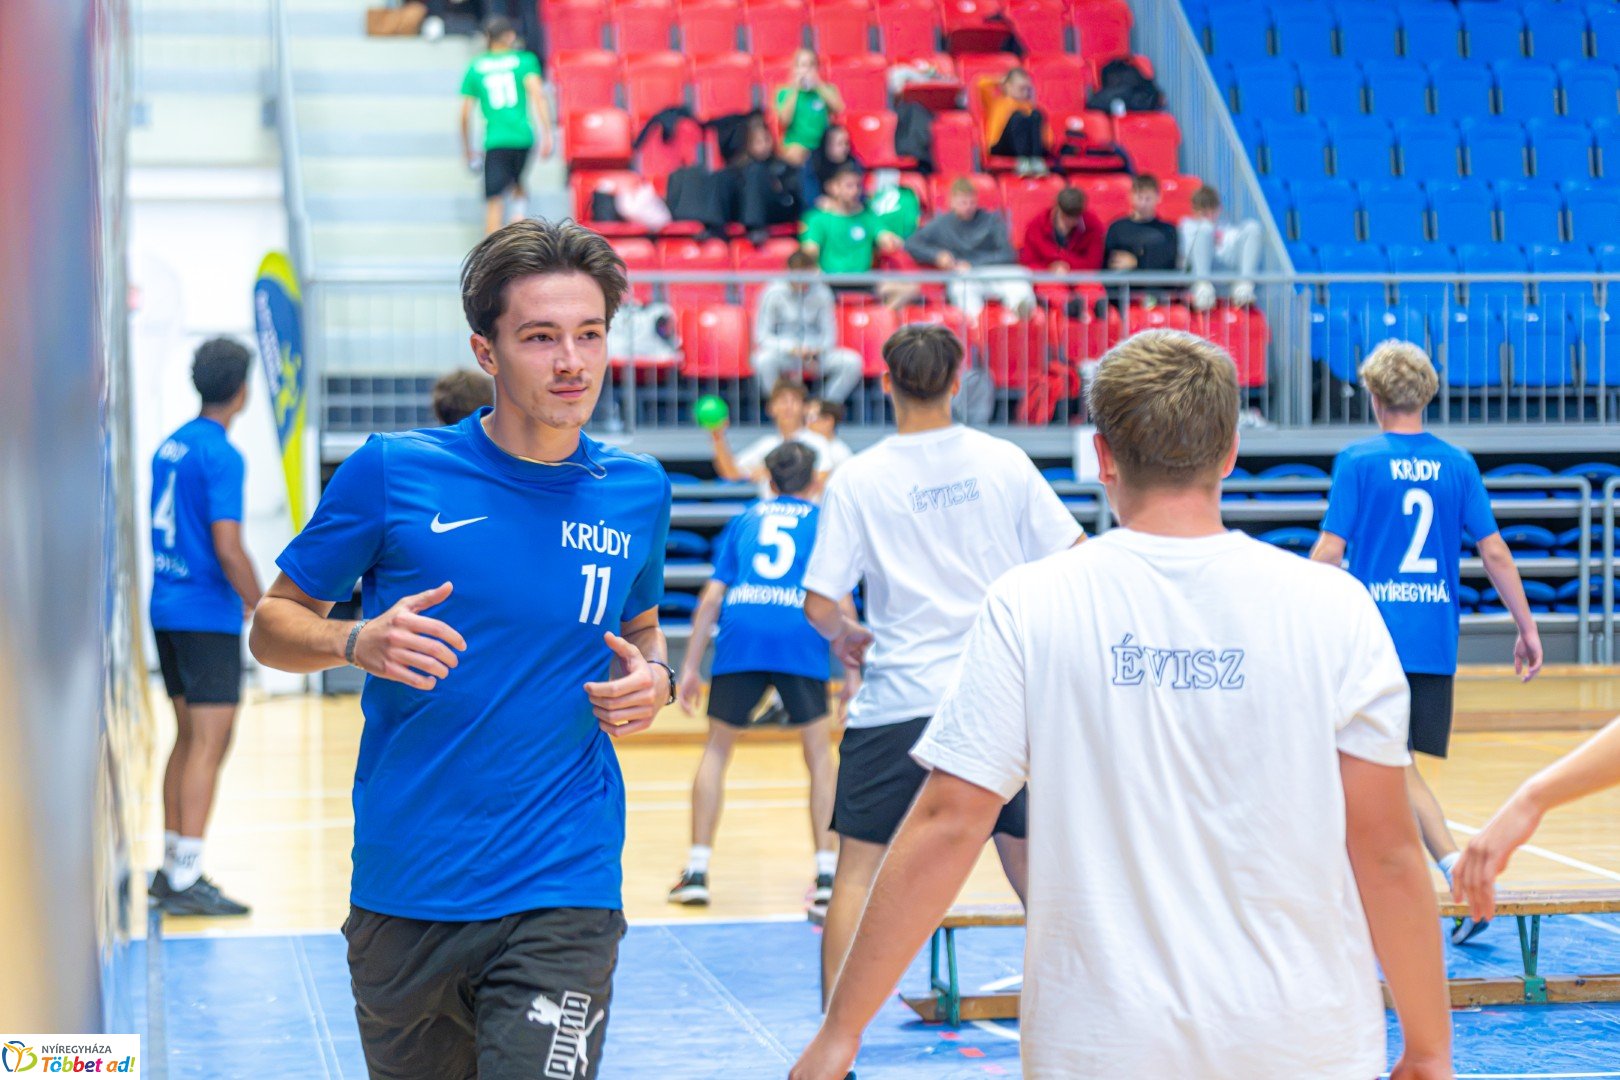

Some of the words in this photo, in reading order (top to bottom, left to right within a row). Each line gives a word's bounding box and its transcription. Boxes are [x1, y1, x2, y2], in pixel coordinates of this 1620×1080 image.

[907, 477, 980, 513] ÉVISZ
[1390, 456, 1441, 481] KRÚDY
[153, 470, 176, 549] 4
[561, 520, 632, 559] KRÚDY
[1399, 488, 1437, 573] 2
[752, 515, 798, 579] 5
[579, 564, 611, 625] 11
[1111, 632, 1245, 689] ÉVISZ
[544, 990, 591, 1080] PUMA
